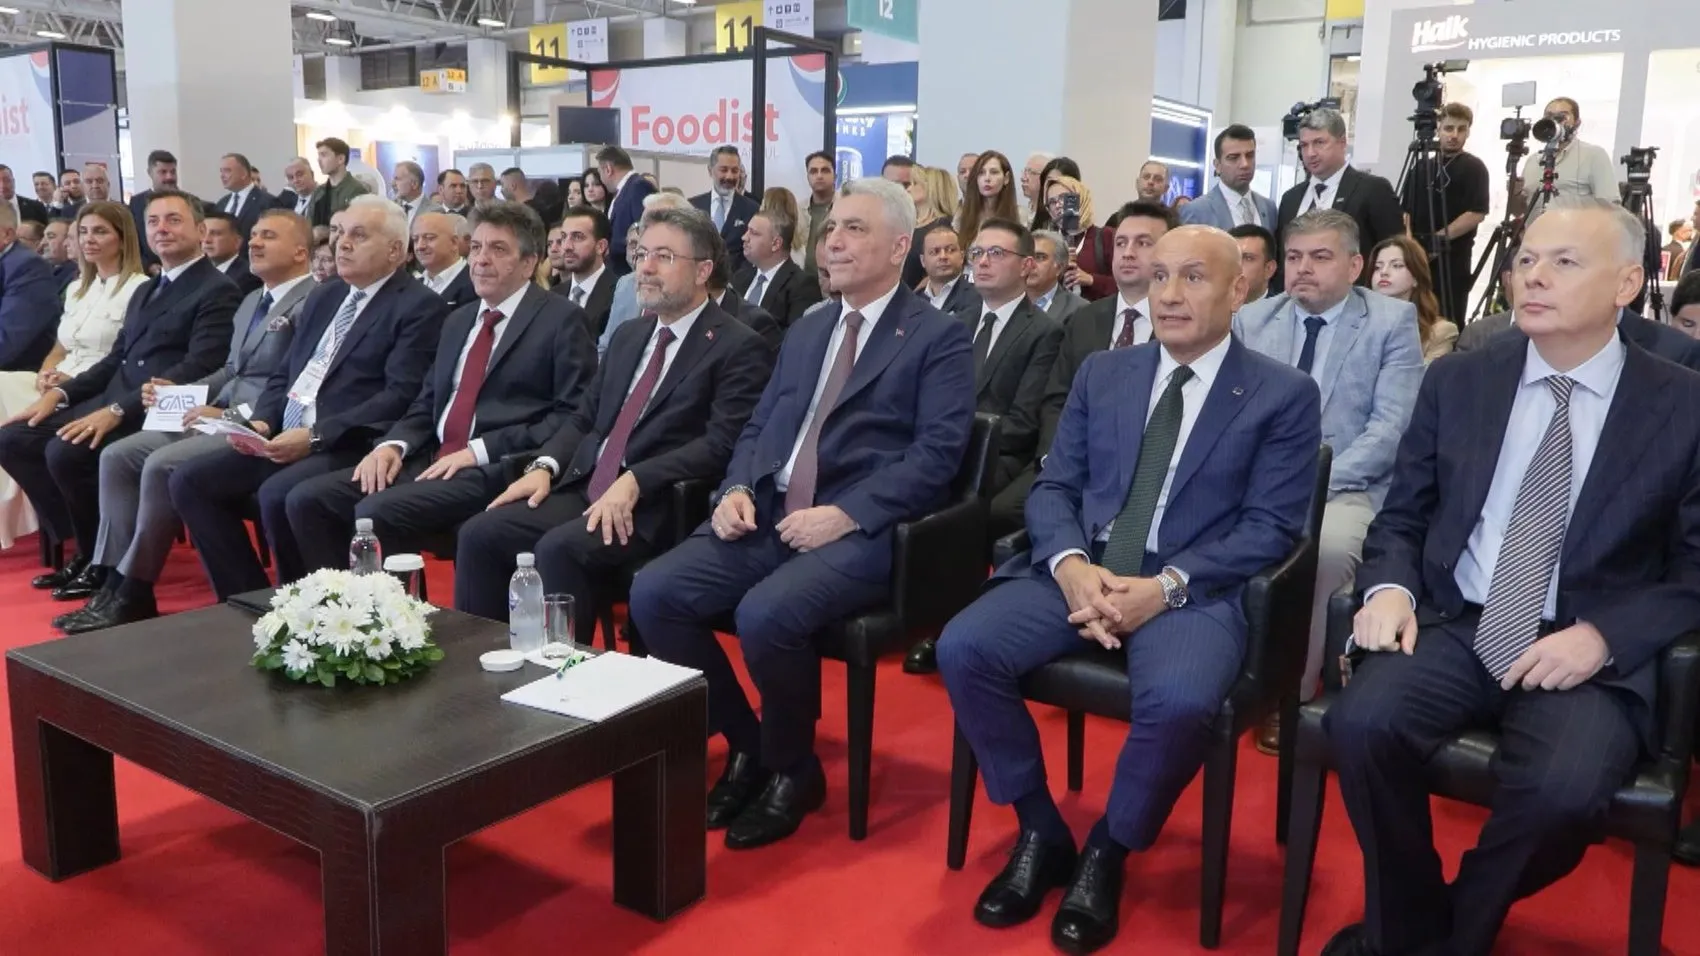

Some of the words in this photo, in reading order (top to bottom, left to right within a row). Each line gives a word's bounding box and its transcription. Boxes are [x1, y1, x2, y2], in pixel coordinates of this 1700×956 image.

[722, 15, 757, 53] 11
[1412, 14, 1470, 46] Halk
[1468, 34, 1536, 50] HYGIENIC
[1538, 29, 1621, 46] PRODUCTS
[535, 36, 560, 70] 11
[0, 94, 30, 135] ist
